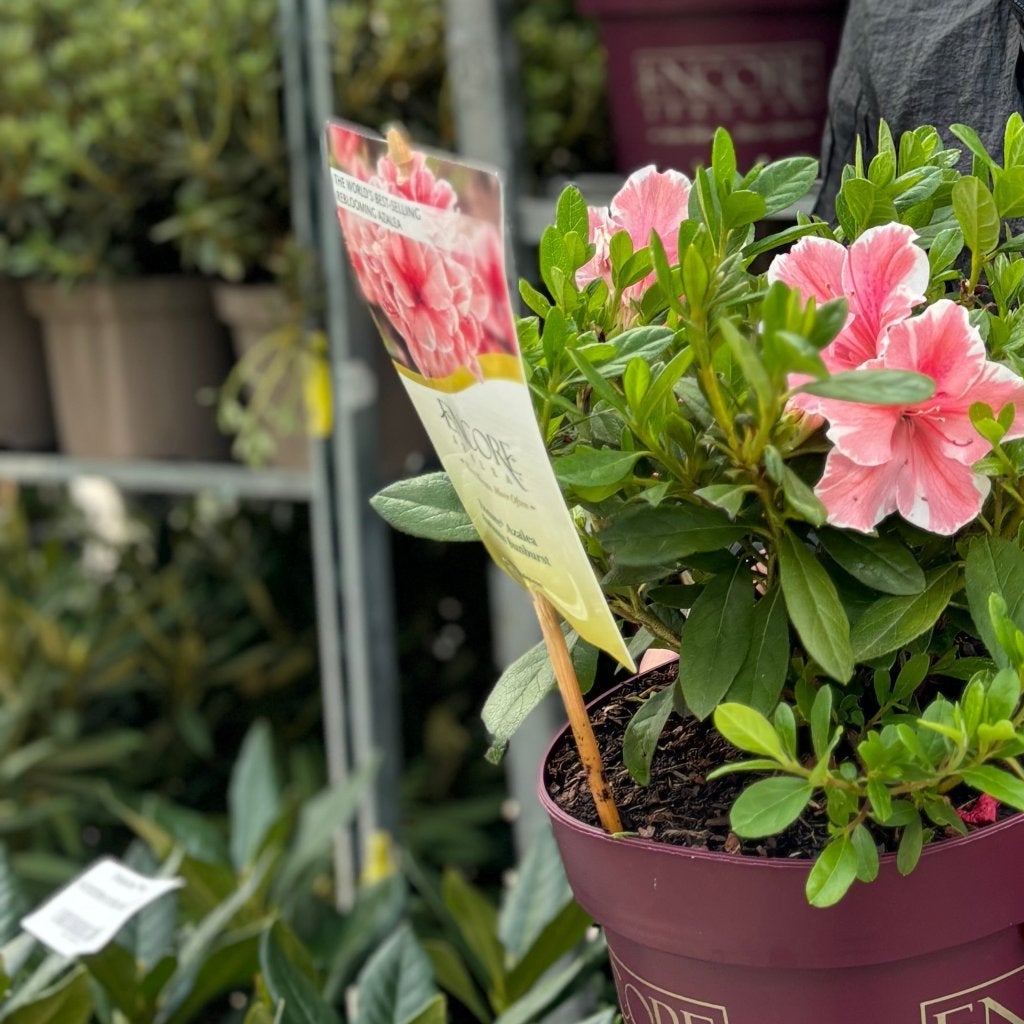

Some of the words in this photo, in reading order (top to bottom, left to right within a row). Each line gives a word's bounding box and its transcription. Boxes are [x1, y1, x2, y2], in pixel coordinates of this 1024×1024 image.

[334, 174, 346, 189] THE
[346, 180, 374, 202] WORLD'S
[374, 192, 421, 221] BEST-SELLING
[336, 190, 377, 219] REBLOOMING
